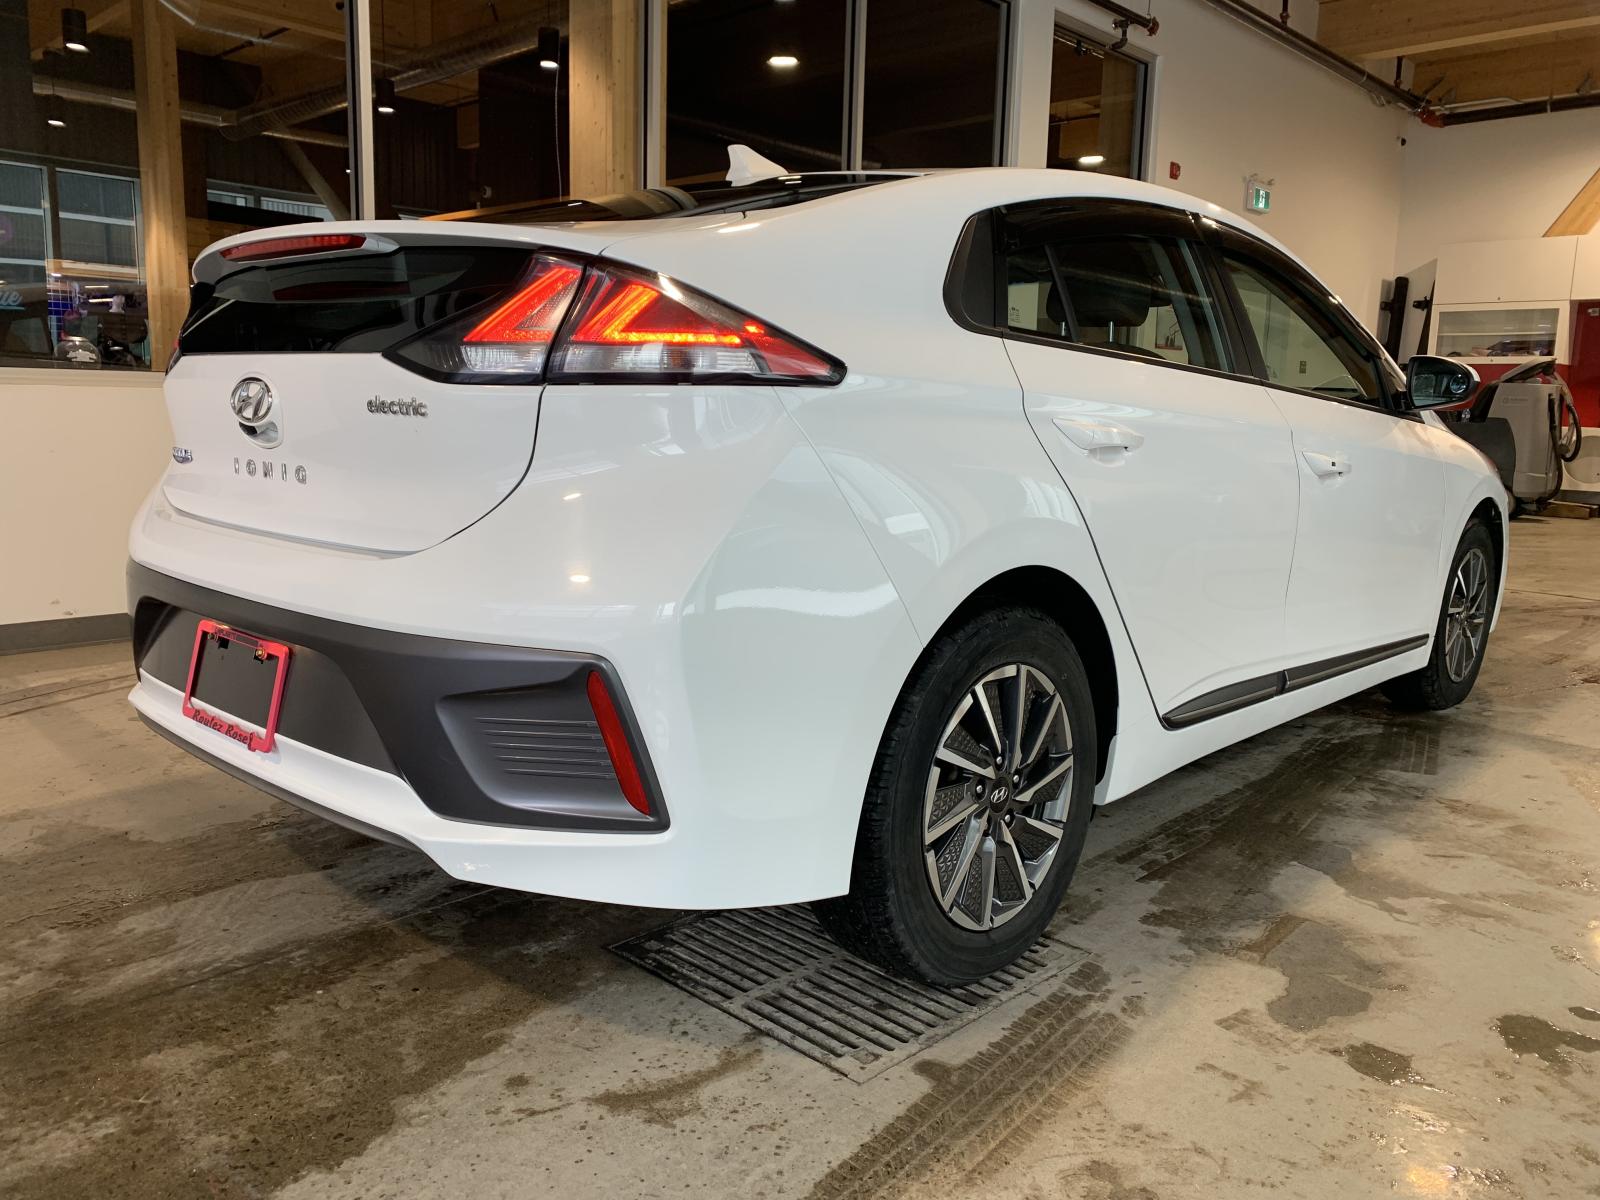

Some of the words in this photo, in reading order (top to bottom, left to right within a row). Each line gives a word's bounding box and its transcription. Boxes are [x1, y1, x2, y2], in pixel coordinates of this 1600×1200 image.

[366, 395, 428, 416] electric
[233, 457, 307, 485] IONIQ
[192, 708, 224, 733] Roulez
